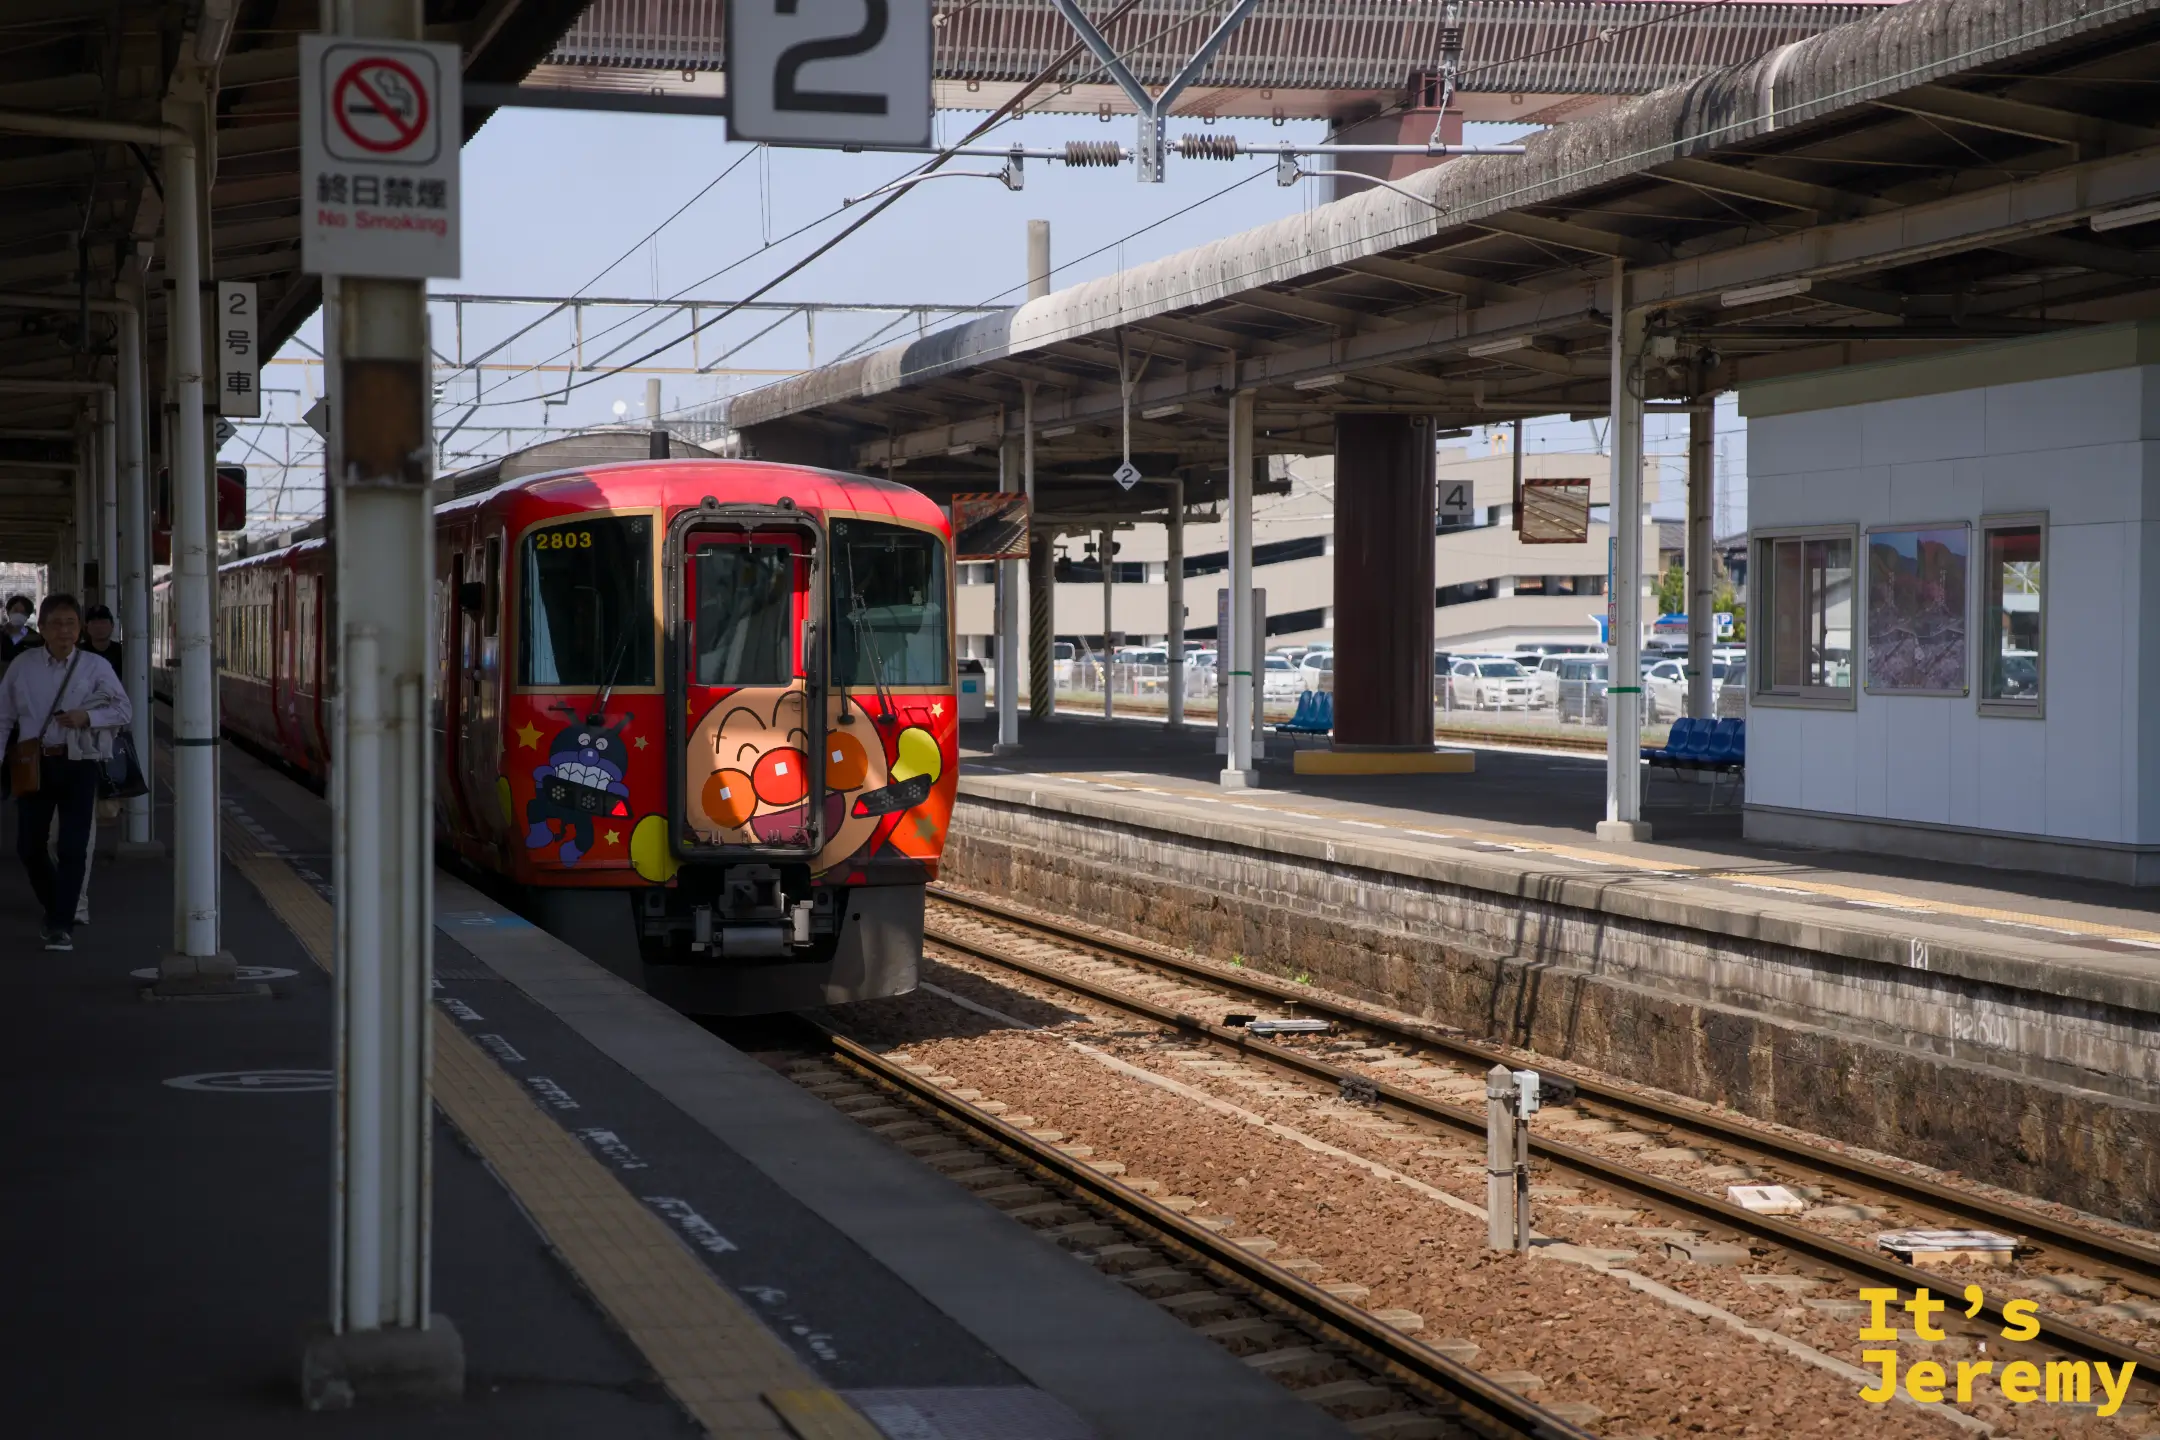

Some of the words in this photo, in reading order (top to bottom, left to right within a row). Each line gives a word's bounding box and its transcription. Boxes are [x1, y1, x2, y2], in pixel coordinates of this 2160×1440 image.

[773, 0, 889, 115] 2
[317, 171, 447, 209] 終日禁煙
[317, 208, 347, 228] No
[355, 210, 447, 239] Smoking
[225, 293, 252, 396] 2号車
[1122, 468, 1134, 484] 2
[1445, 484, 1467, 510] 4
[536, 531, 592, 550] 2803
